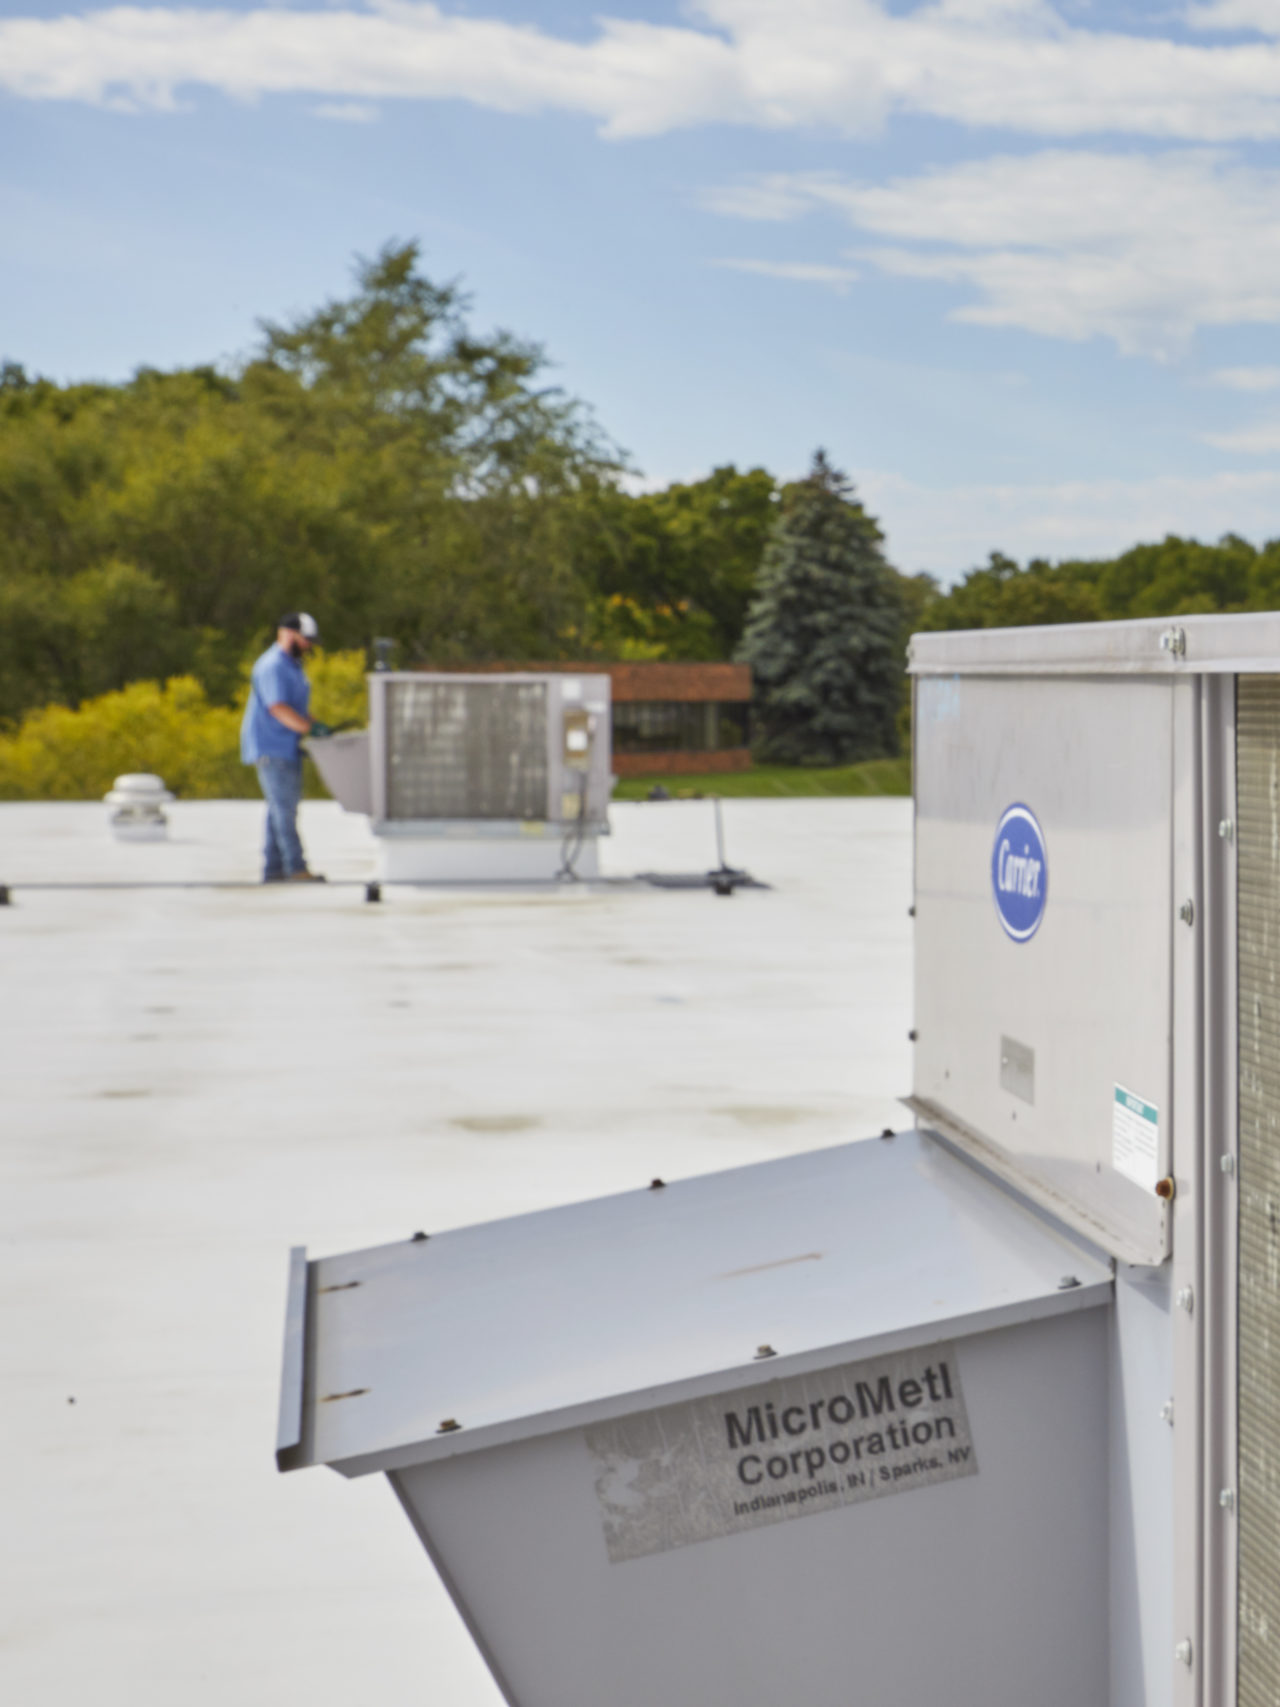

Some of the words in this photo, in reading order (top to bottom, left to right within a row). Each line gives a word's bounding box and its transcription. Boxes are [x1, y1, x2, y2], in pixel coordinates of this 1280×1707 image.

[998, 839, 1041, 898] Carrier
[724, 1362, 954, 1449] MicroMetl
[737, 1415, 957, 1487] Corporation
